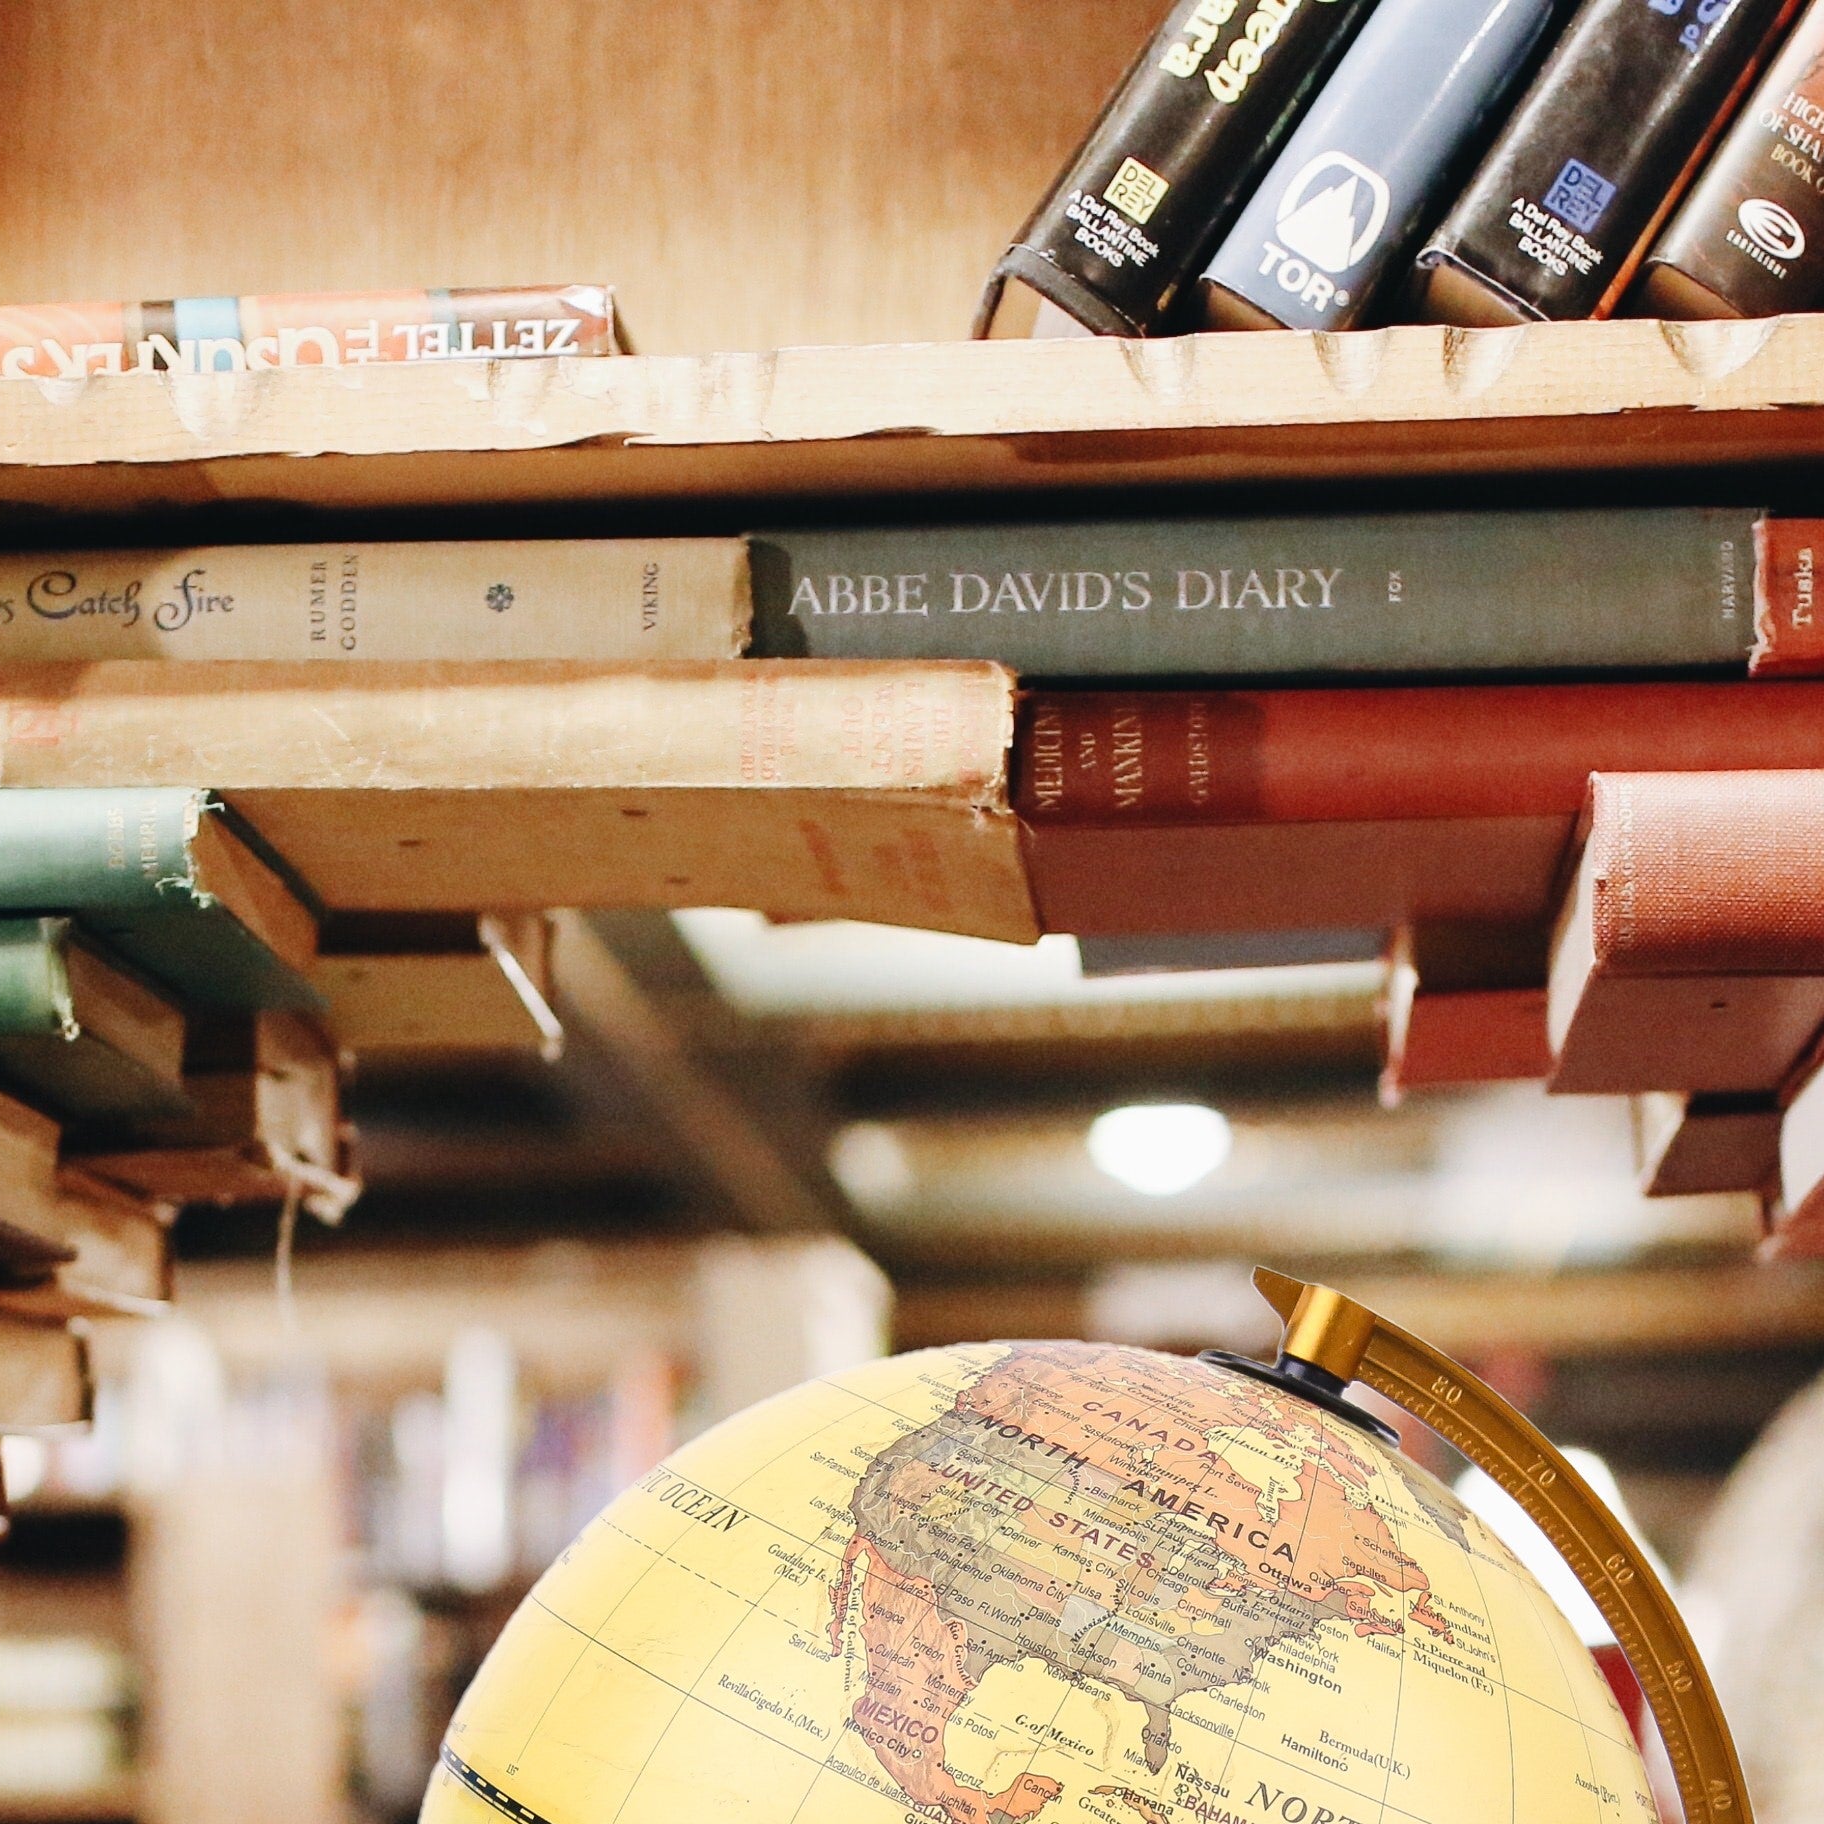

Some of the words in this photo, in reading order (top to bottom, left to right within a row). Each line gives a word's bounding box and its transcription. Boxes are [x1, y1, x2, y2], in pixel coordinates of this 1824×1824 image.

[1758, 110, 1785, 136] OF
[1111, 182, 1153, 216] REY
[1122, 165, 1157, 201] DEL
[1065, 203, 1150, 267] BALLANTINE
[1074, 226, 1125, 268] BOOKS
[393, 317, 578, 362] ZETTEL
[27, 570, 140, 621] Catch
[154, 569, 234, 631] Fire
[310, 560, 326, 642] RUMER
[339, 553, 358, 651] GODDEN
[642, 563, 658, 631] VIKING
[788, 574, 928, 619] ABBE
[950, 572, 1153, 615] DAVID'S
[1177, 567, 1343, 611] DIARY
[1387, 569, 1403, 601] FOX
[1792, 546, 1814, 626] Tuska
[1082, 1400, 1220, 1464] CANADA
[975, 1413, 1091, 1469] NORTH
[1123, 1478, 1296, 1562] AMERICA
[1091, 1485, 1143, 1513] Bismarck
[939, 1463, 1035, 1515] UNITED
[1047, 1509, 1157, 1571] STATES
[1006, 1524, 1042, 1552] Denver
[1146, 1567, 1190, 1595] Chicago
[1258, 1561, 1314, 1594] Ottawa
[1176, 1599, 1232, 1629] Cincinnati
[1252, 1644, 1343, 1694] Washington
[858, 1696, 940, 1748] MEXICO
[1174, 1763, 1232, 1800] Nassau
